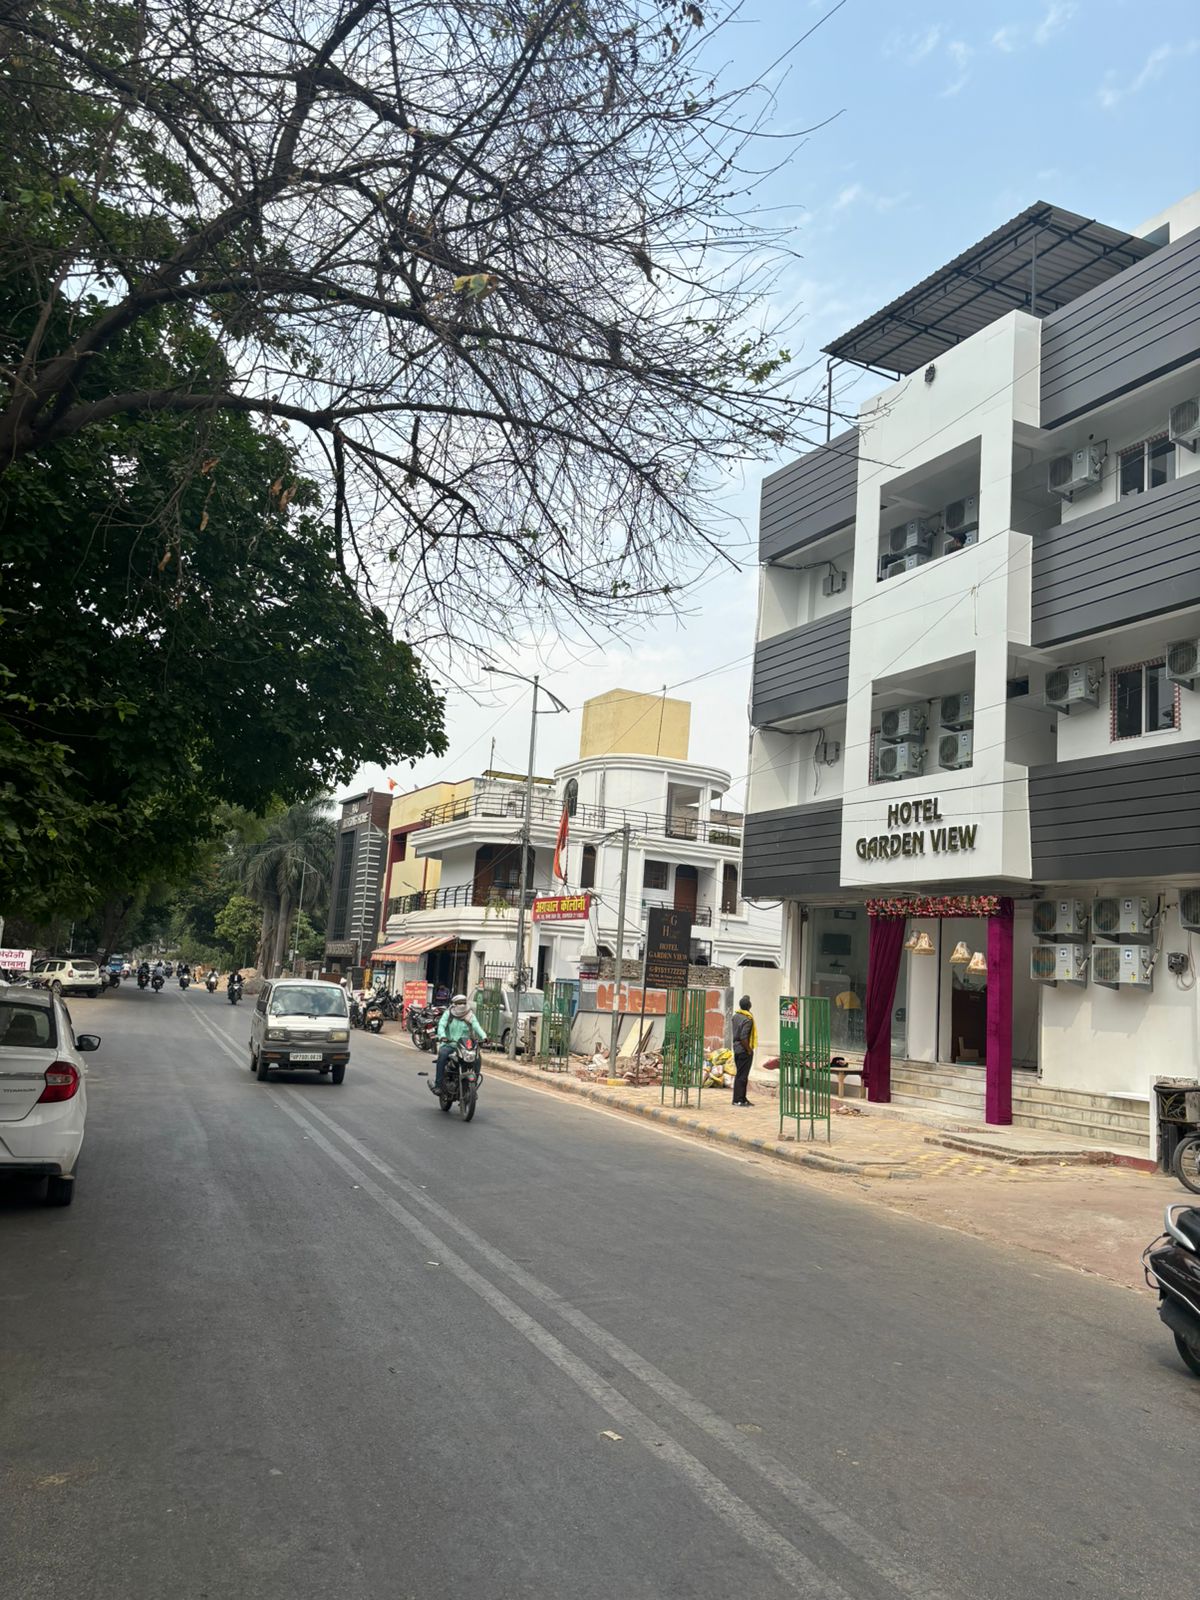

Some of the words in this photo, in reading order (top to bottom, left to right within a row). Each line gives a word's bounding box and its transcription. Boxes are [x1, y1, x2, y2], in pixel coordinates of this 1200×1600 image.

[887, 797, 943, 829] HOTEL
[856, 831, 925, 860] GARDEN
[930, 824, 978, 853] VIEW
[560, 895, 586, 911] कॉलोनी
[658, 943, 679, 951] HOTEL
[648, 951, 672, 960] GARDEN
[673, 953, 688, 961] VIEW
